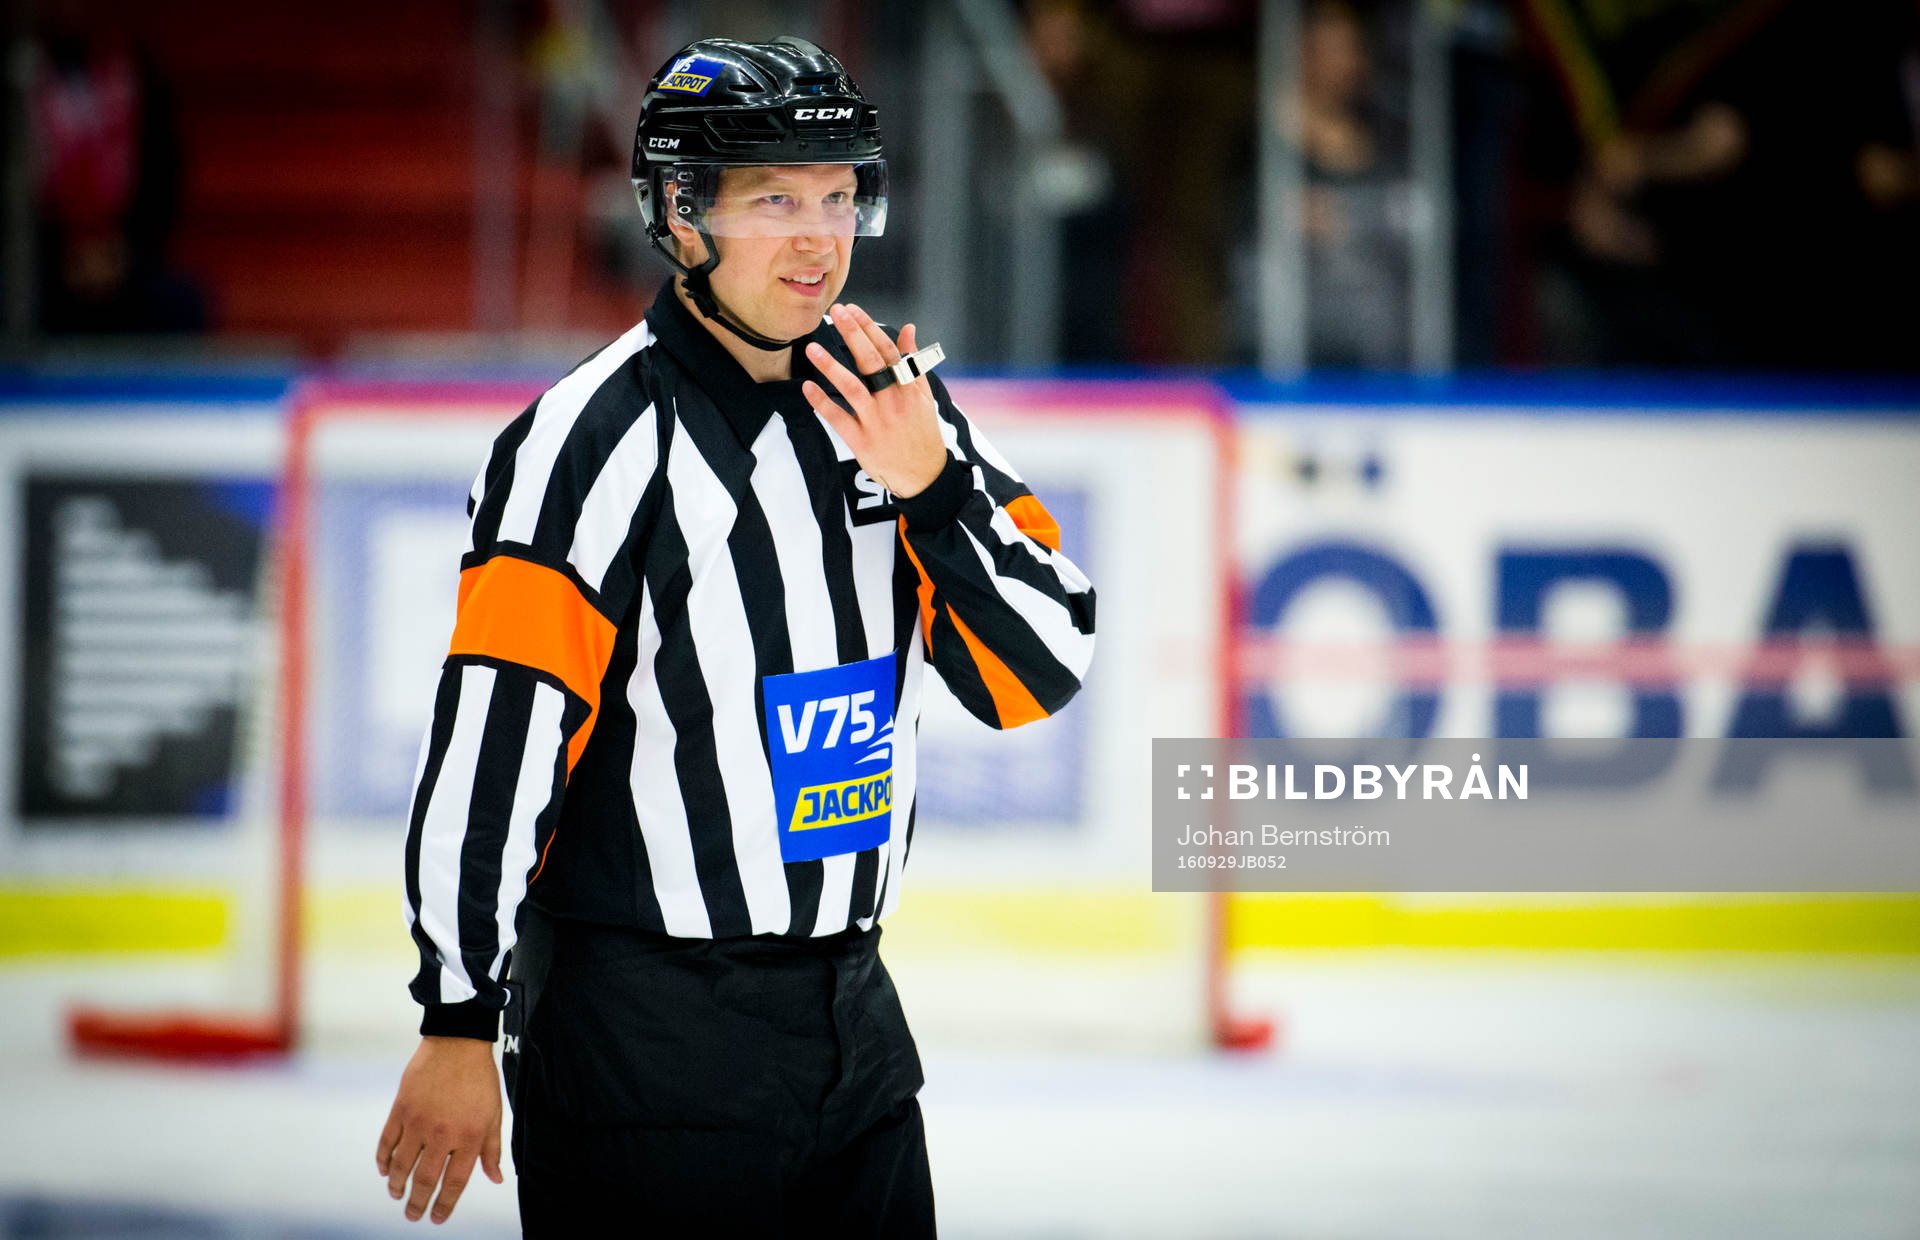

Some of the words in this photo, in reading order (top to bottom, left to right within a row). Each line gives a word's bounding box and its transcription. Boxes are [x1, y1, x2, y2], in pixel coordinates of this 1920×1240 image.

[794, 107, 854, 121] CCM
[649, 137, 681, 149] CCM
[777, 689, 876, 755] V75
